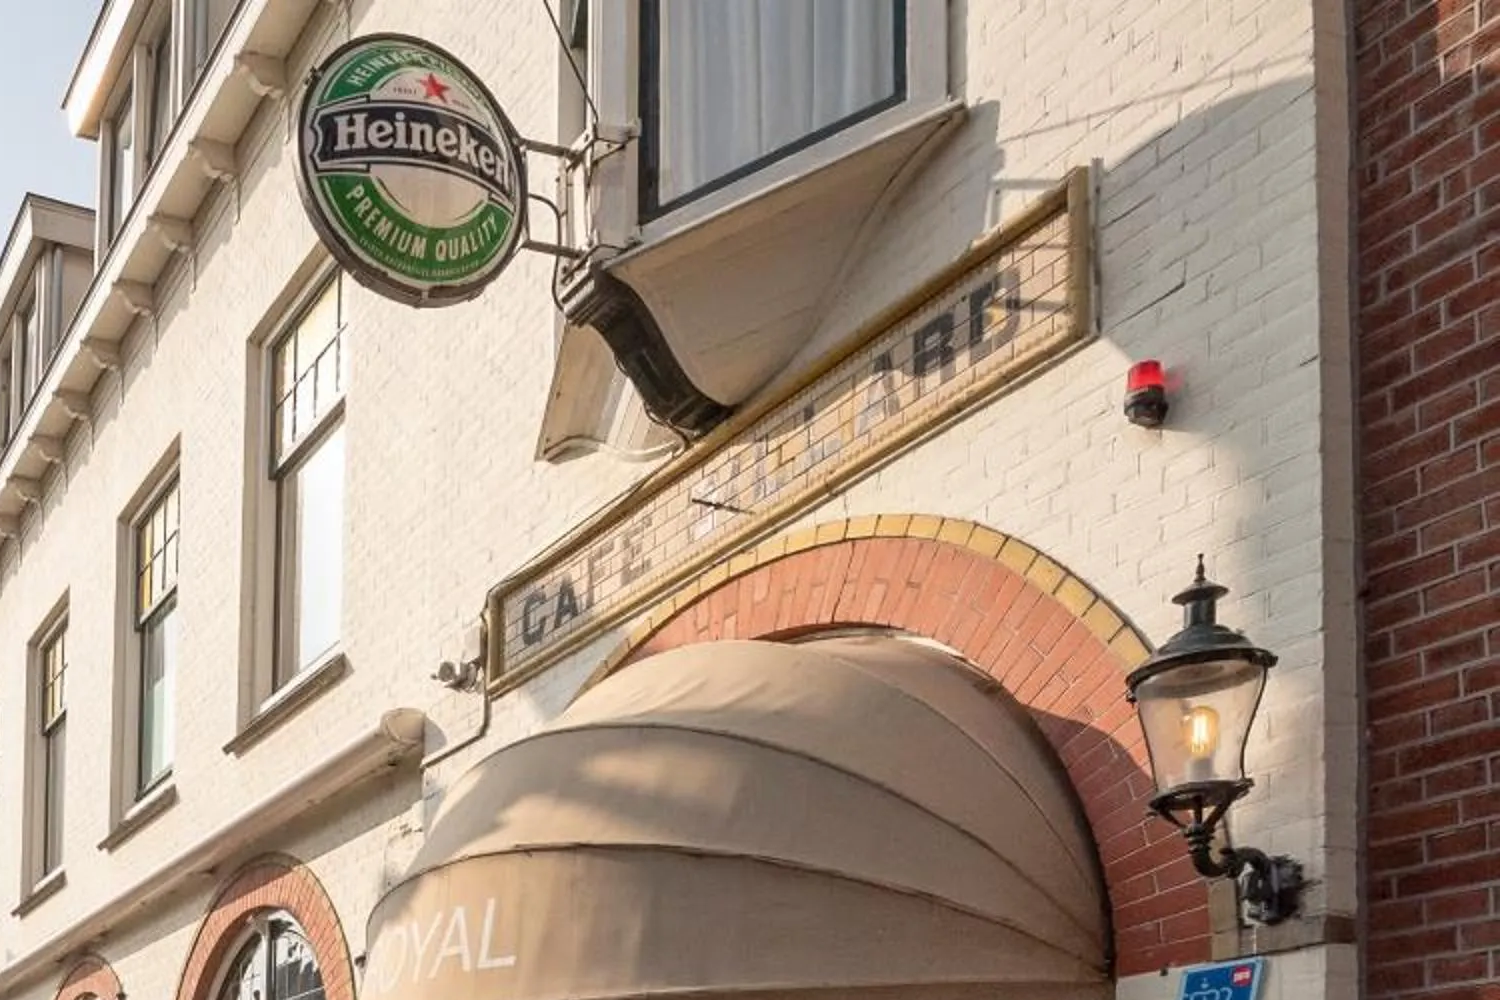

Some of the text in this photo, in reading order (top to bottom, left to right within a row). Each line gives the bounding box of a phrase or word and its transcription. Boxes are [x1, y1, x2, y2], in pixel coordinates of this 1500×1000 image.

[333, 111, 509, 193] Heineken
[346, 185, 428, 260] PREMIUM
[434, 214, 498, 262] QUALITY
